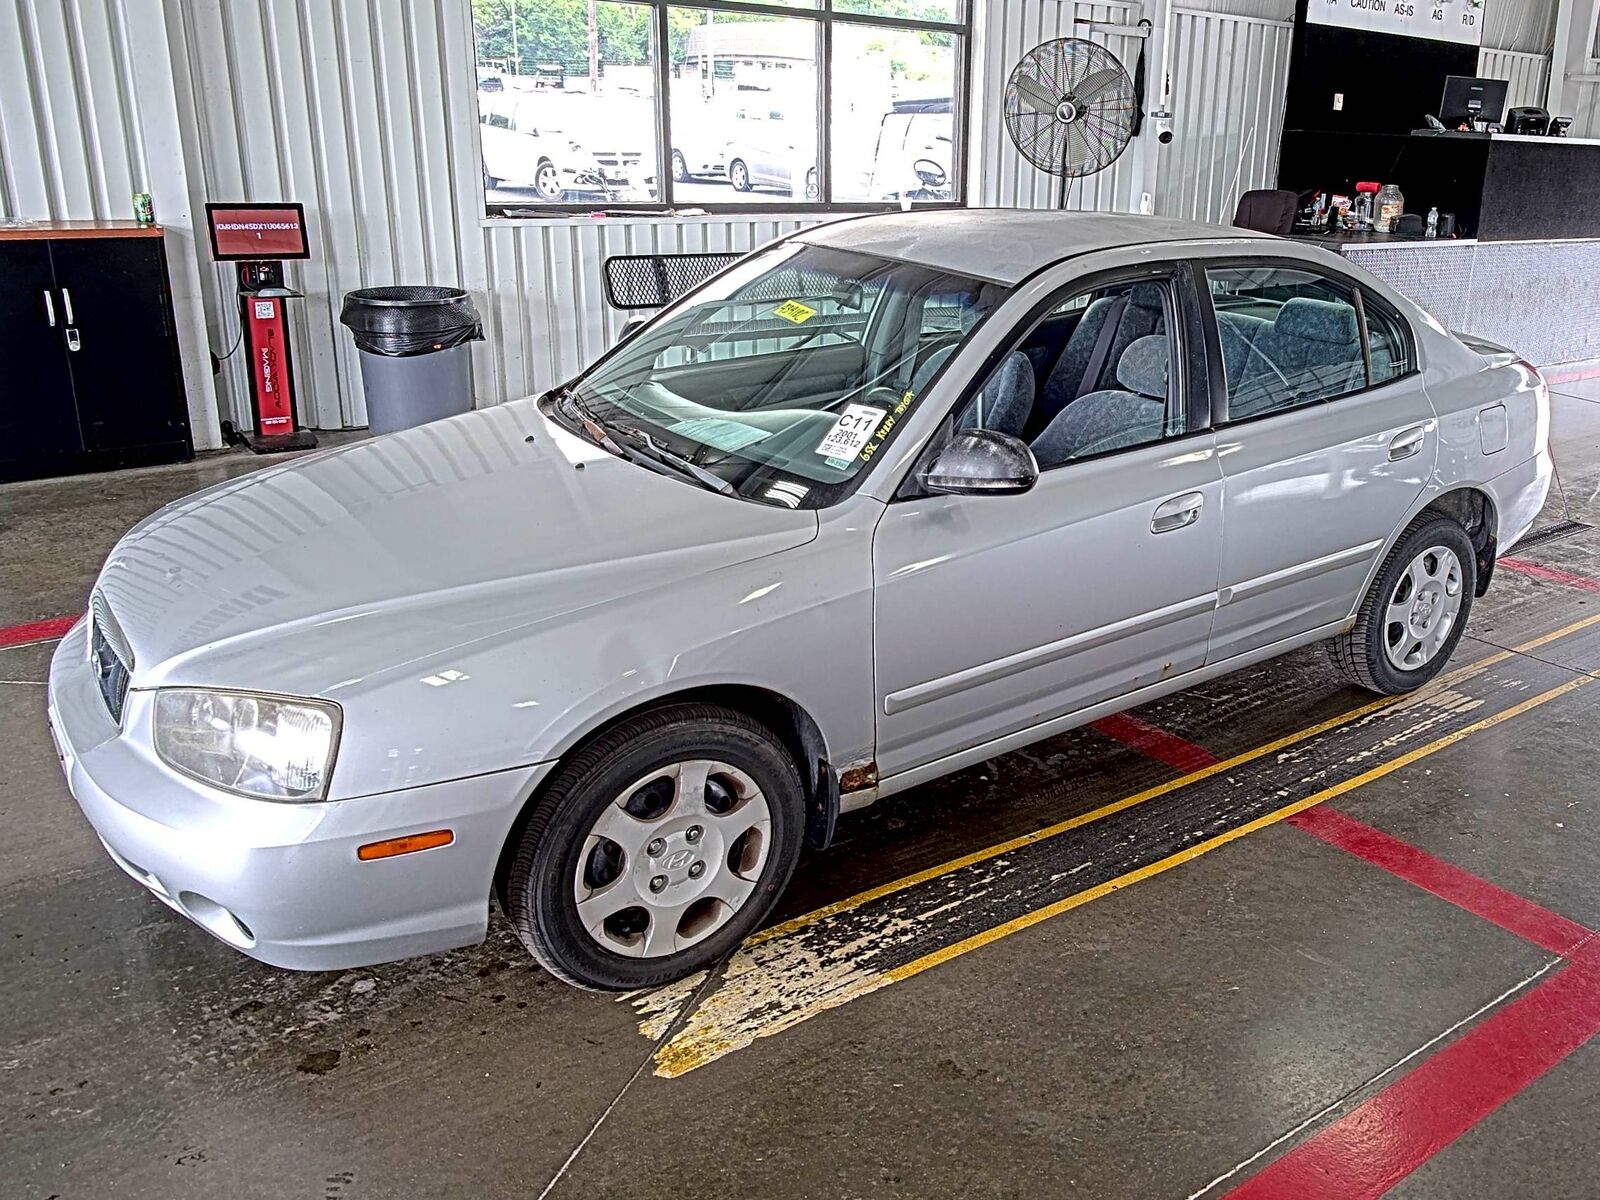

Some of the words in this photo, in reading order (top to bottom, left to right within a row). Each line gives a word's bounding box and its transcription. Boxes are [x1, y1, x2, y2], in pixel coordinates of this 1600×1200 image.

[1351, 0, 1386, 12] CAUTION
[1393, 3, 1414, 17] AS-IS
[1432, 9, 1443, 21] AG
[256, 232, 262, 240] 1
[261, 347, 273, 393] IMAGING
[839, 414, 873, 432] C11
[827, 434, 861, 449] 123,612
[836, 429, 858, 440] 2001
